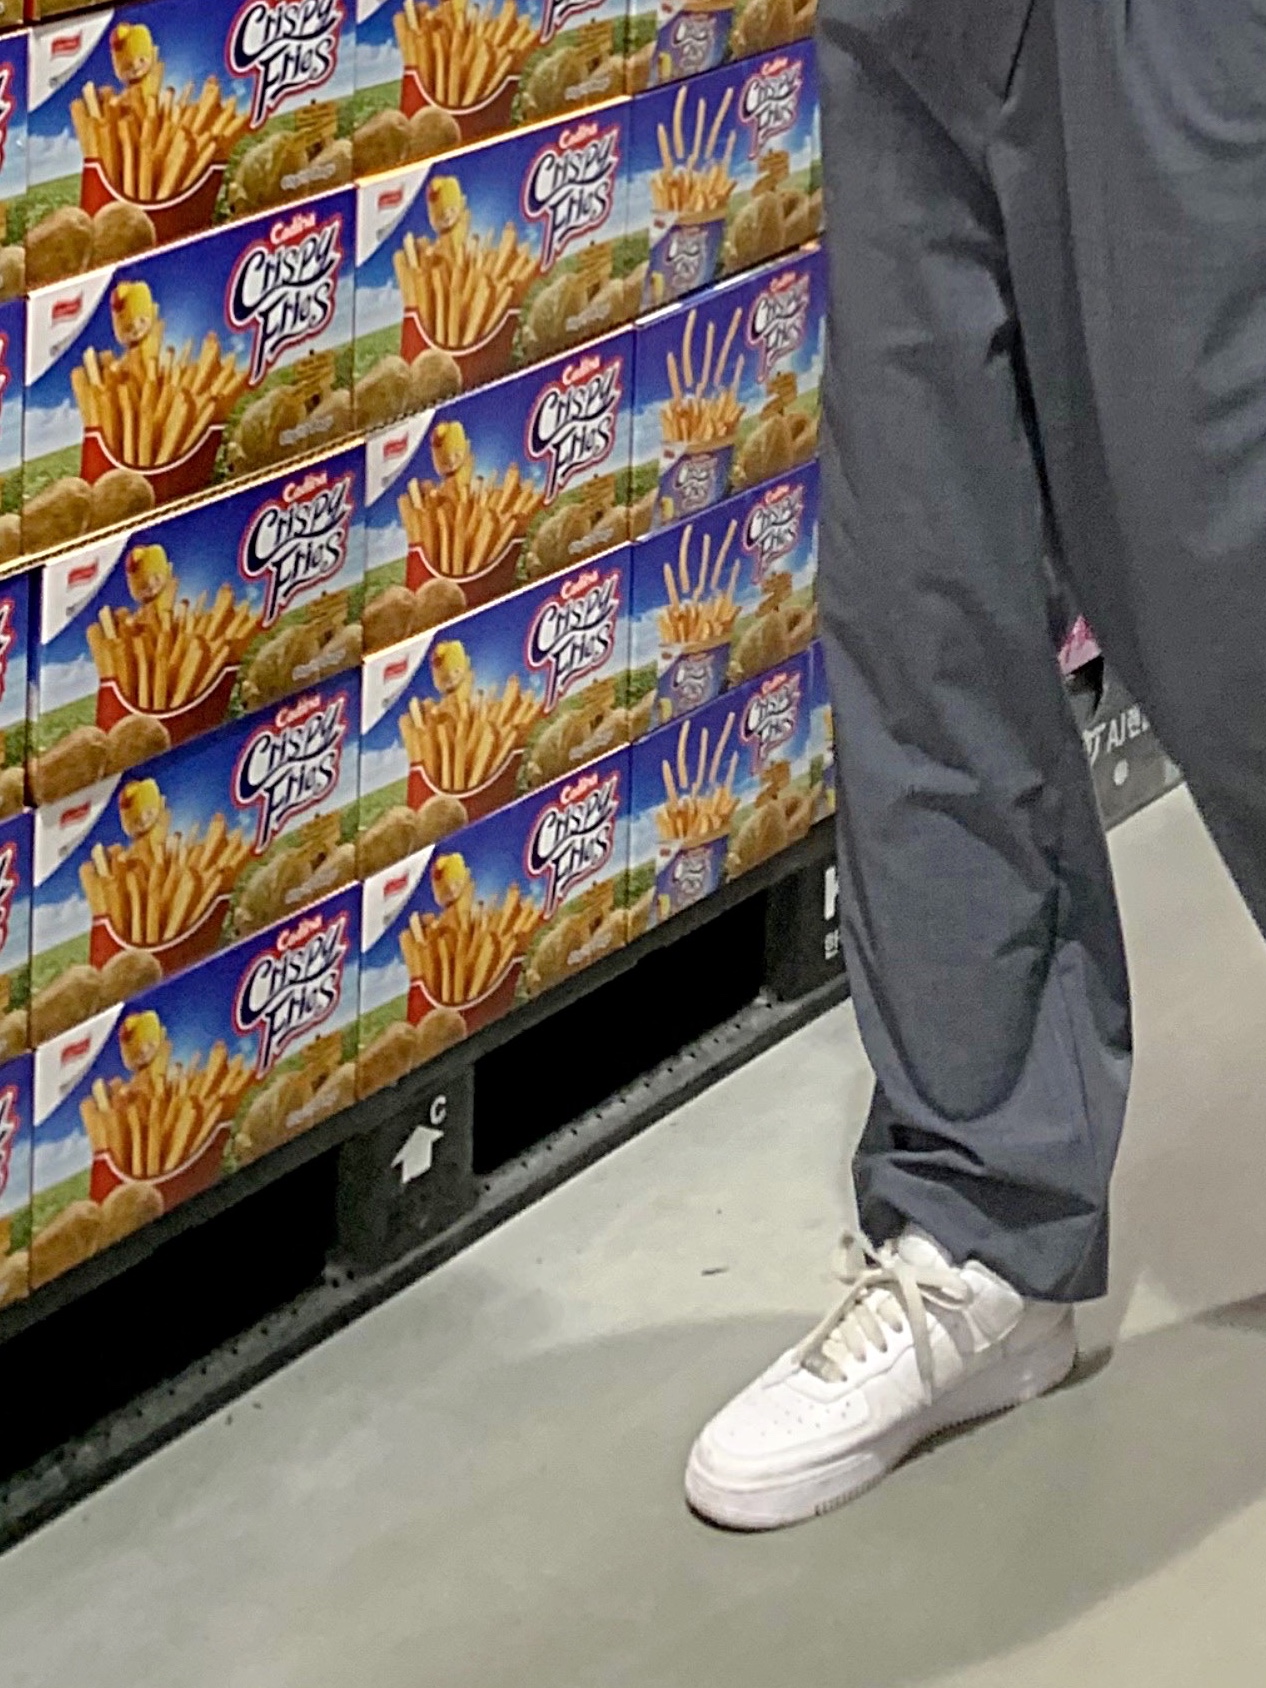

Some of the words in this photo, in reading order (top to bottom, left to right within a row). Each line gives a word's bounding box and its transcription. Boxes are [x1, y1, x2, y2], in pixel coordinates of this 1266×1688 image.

[251, 39, 329, 127] Fries
[529, 132, 618, 210] Crispy
[542, 181, 609, 269] Fries
[232, 224, 341, 321] Crispy
[250, 285, 330, 382] Fries
[532, 364, 621, 445] Crispy
[545, 412, 611, 504] Fries
[245, 484, 351, 568] Crispy
[264, 532, 343, 627] Fries
[531, 577, 620, 660] Crispy
[545, 623, 610, 711] Fries
[237, 704, 345, 795] Crispy
[256, 756, 338, 852] Fries
[531, 777, 618, 863] Crispy
[545, 828, 611, 917] Fries
[238, 922, 346, 1029] Crispy
[257, 976, 341, 1077] Fries
